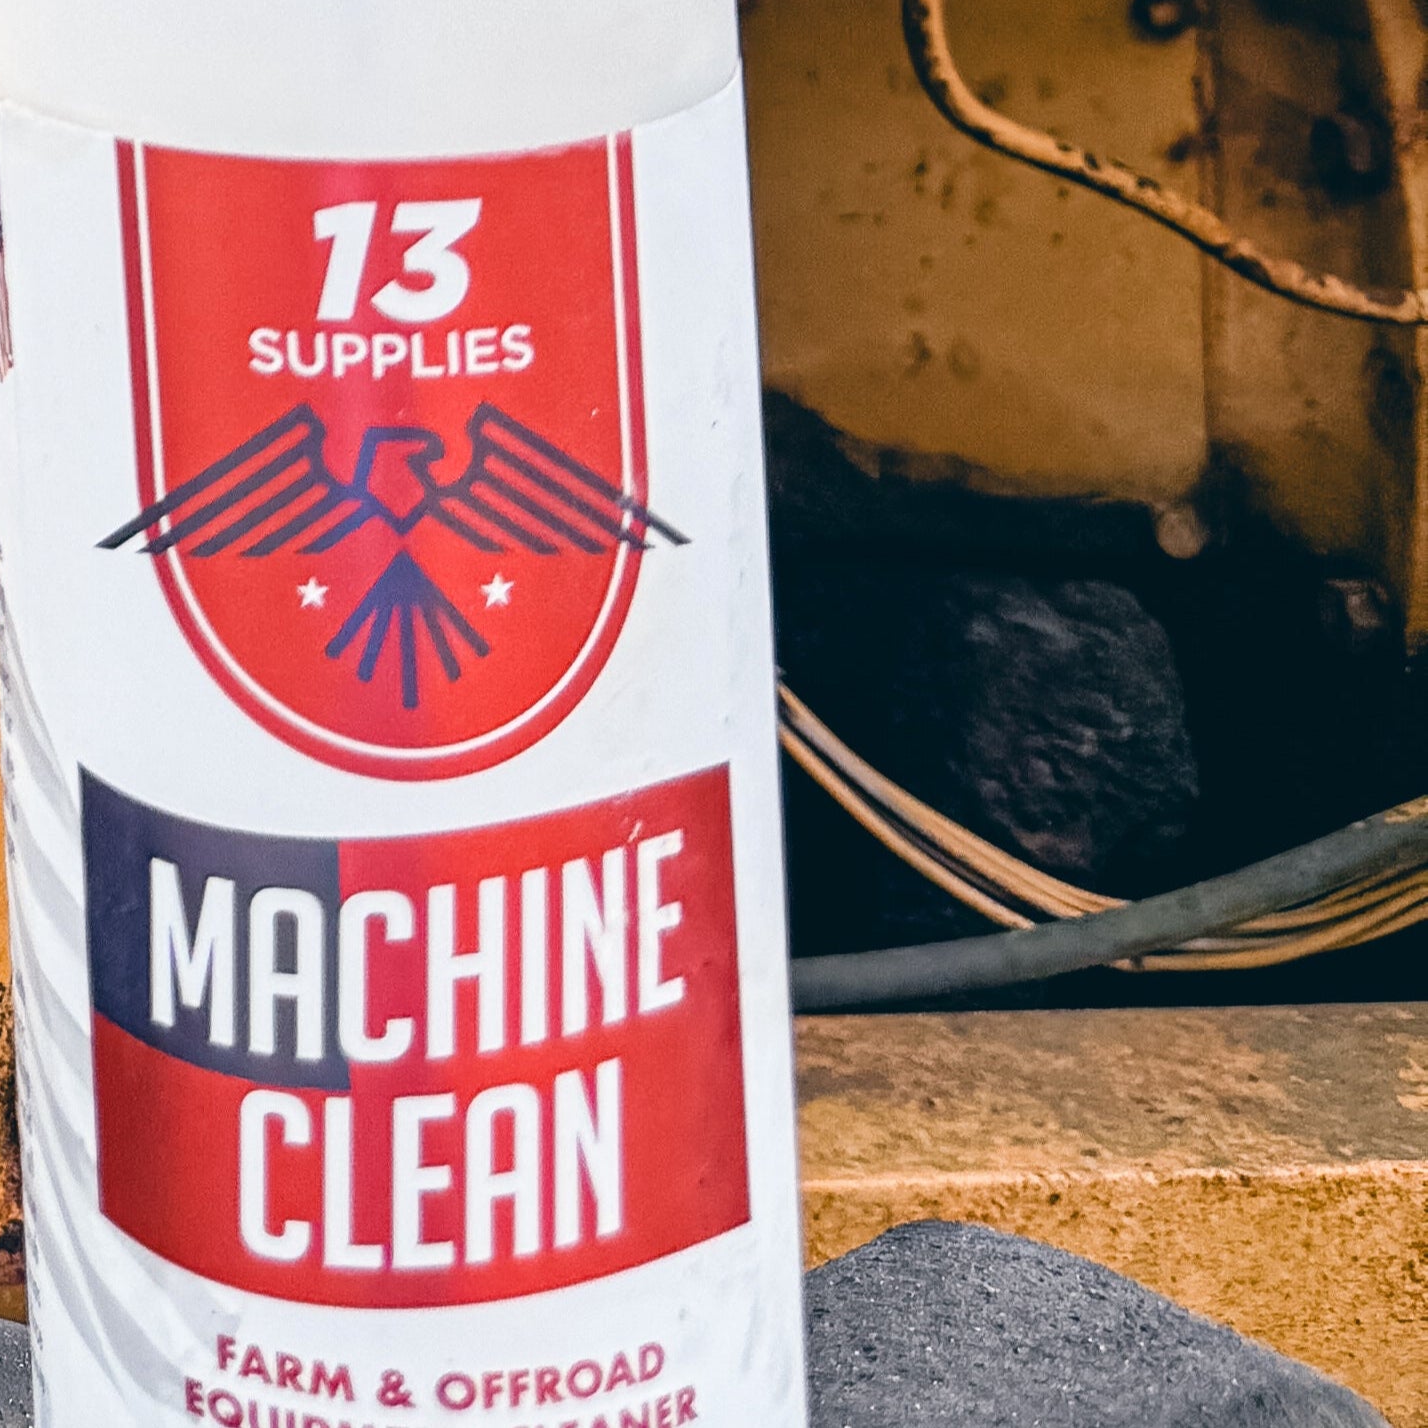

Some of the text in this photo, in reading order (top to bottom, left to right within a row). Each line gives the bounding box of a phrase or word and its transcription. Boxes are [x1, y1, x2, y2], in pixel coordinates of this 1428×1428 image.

[313, 197, 483, 326] 13
[248, 323, 535, 379] SUPPLIES
[149, 829, 684, 1063] MACHINE
[238, 1058, 624, 1271] CLEAN
[217, 1334, 355, 1402] FARM
[376, 1368, 415, 1408] &
[435, 1342, 665, 1411] OFFROAD
